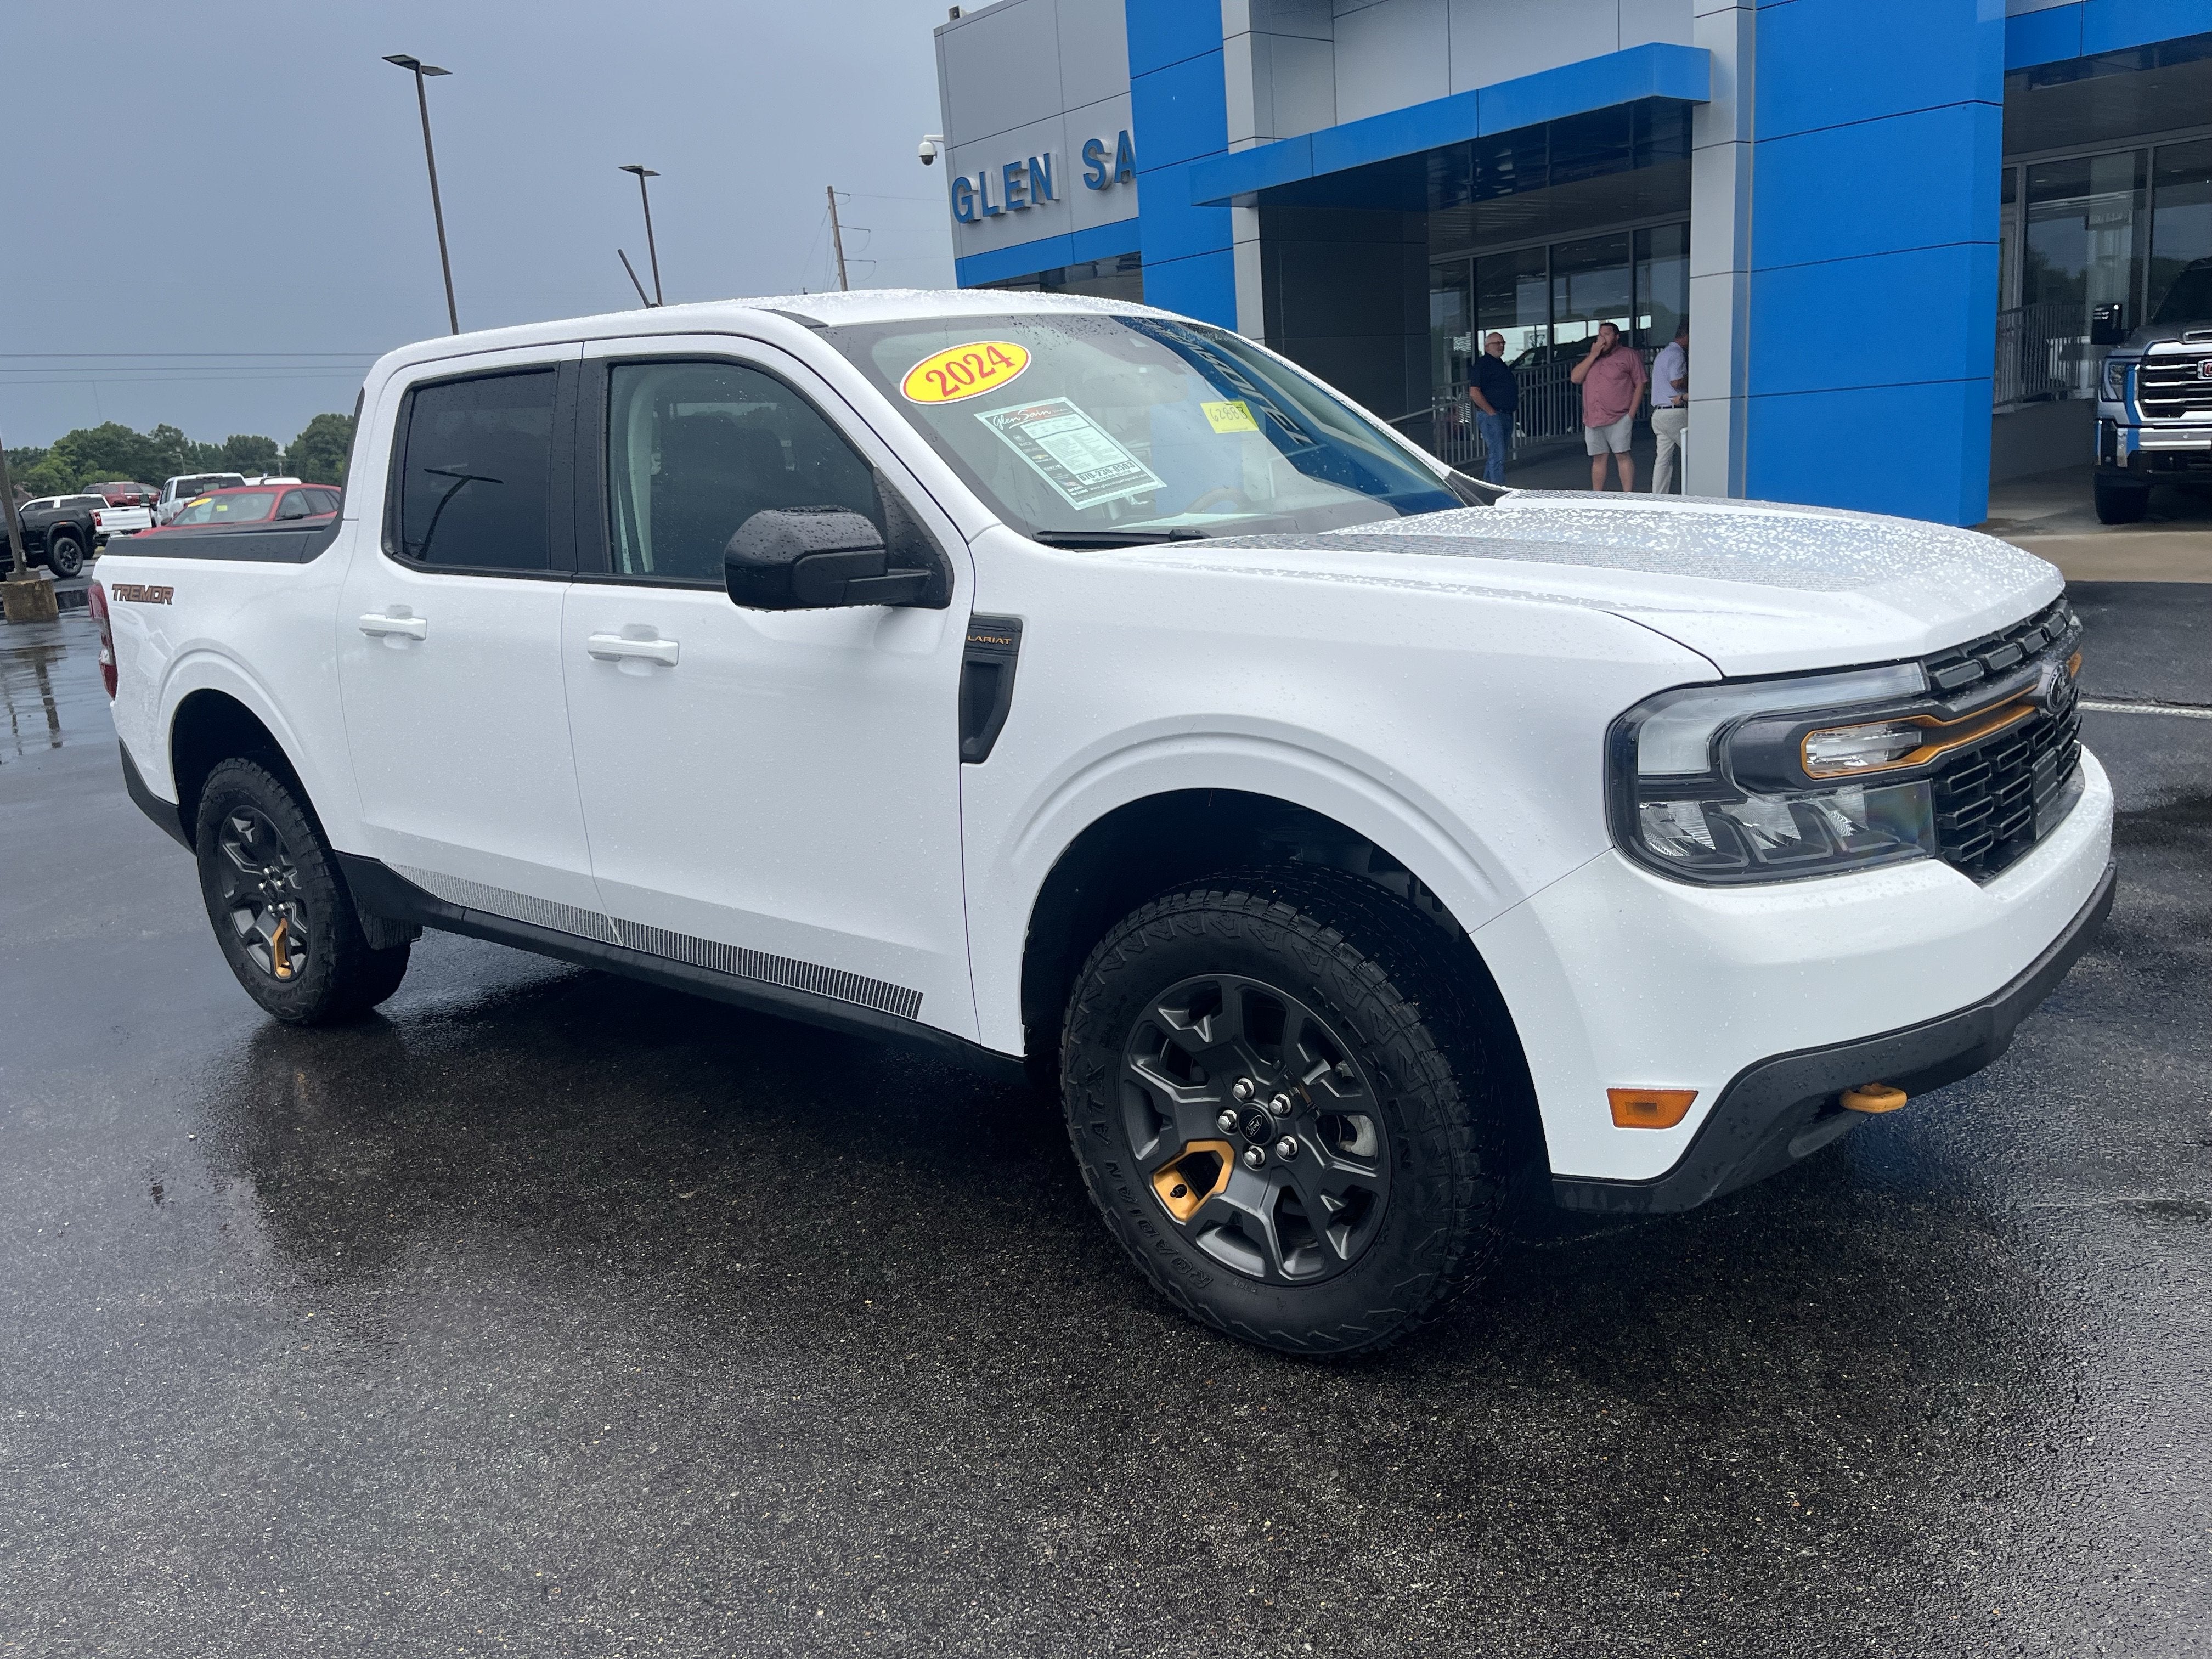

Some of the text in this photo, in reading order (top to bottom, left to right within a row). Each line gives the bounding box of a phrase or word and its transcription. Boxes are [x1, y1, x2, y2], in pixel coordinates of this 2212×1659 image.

[952, 153, 1060, 223] GLEN
[925, 345, 1015, 397] 2024
[993, 415, 1021, 430] Glen
[1018, 409, 1051, 421] Sain
[1079, 462, 1135, 481] 870-236-8503
[112, 584, 174, 605] TREMOR
[968, 635, 1012, 645] LARIAT
[1248, 1119, 1260, 1135] Ford
[1090, 1062, 1214, 1289] ROADIAN ATX
